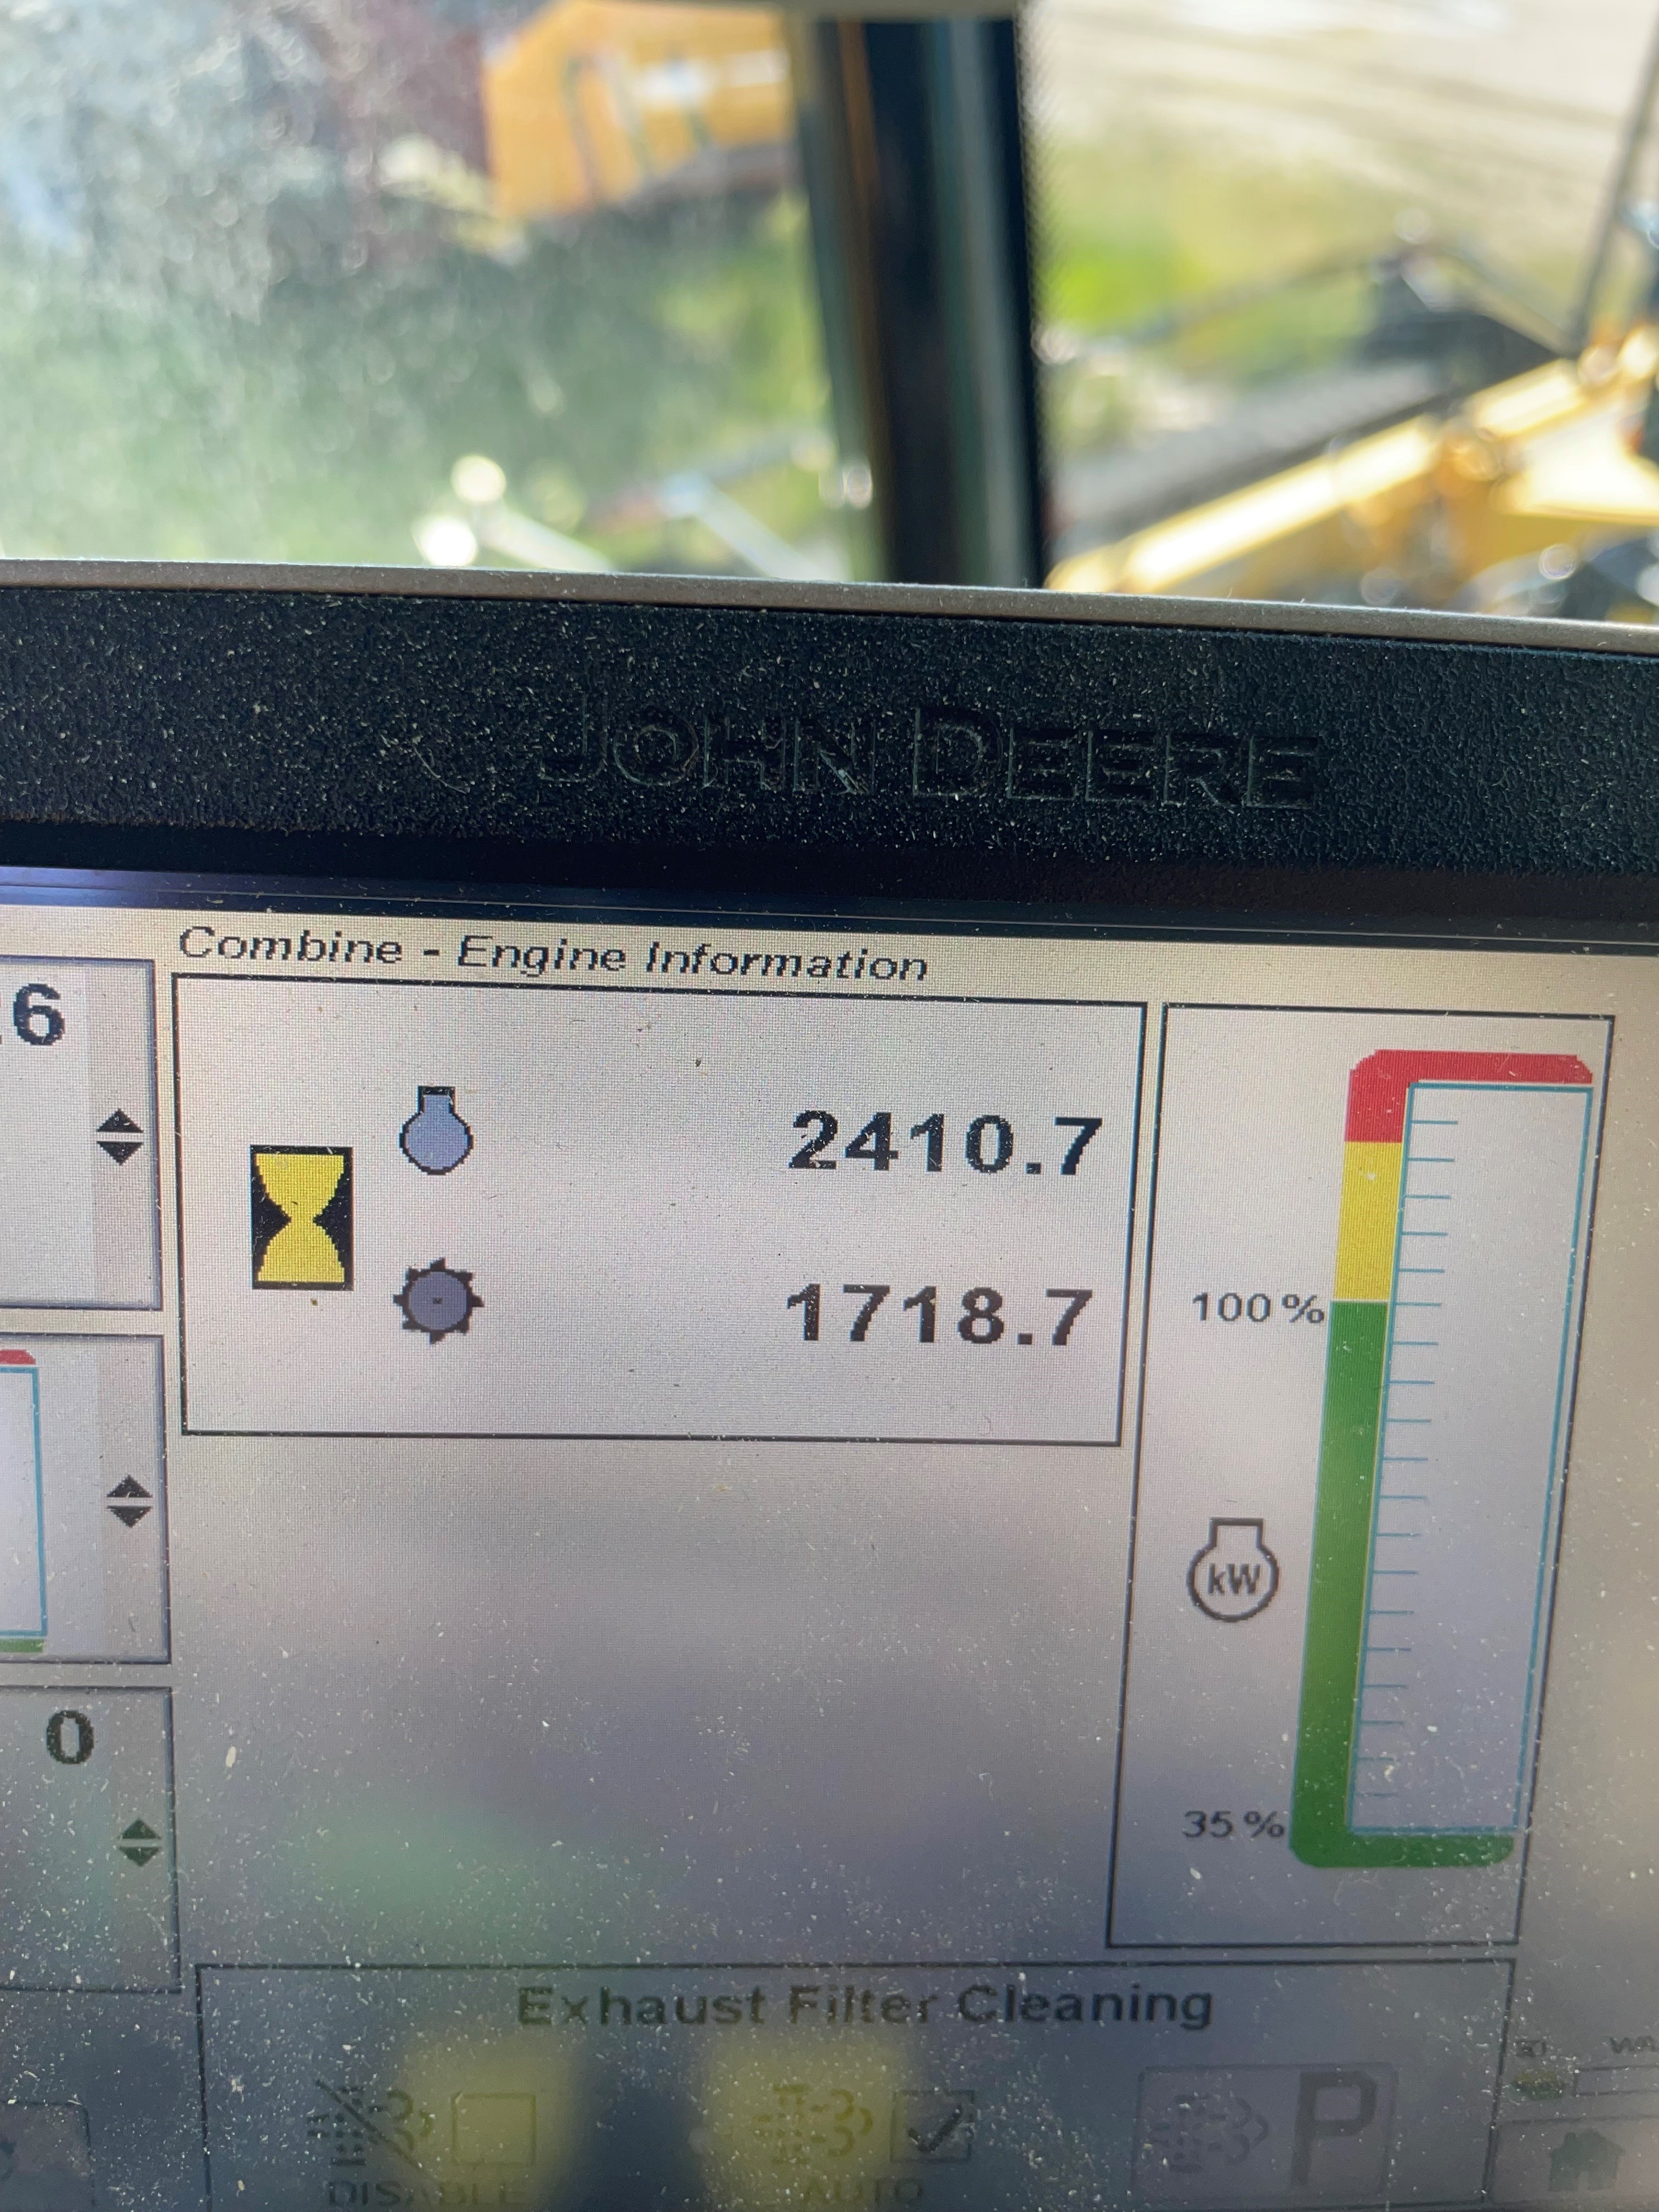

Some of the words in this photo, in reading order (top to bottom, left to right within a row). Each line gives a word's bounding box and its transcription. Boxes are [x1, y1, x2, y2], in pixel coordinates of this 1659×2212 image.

[539, 696, 874, 795] JOHN
[913, 707, 1319, 810] DEERE
[179, 926, 403, 964] Combine
[458, 934, 627, 978] Engine
[646, 940, 928, 981] Information
[788, 1109, 1103, 1175] 2410.7
[786, 1282, 1093, 1346] 1718.7
[1207, 1562, 1261, 1595] kW
[46, 1709, 94, 1765] 0
[518, 1983, 765, 2025] Exhaust
[788, 1984, 937, 2025] Filter
[957, 1983, 1213, 2030] Cleaning
